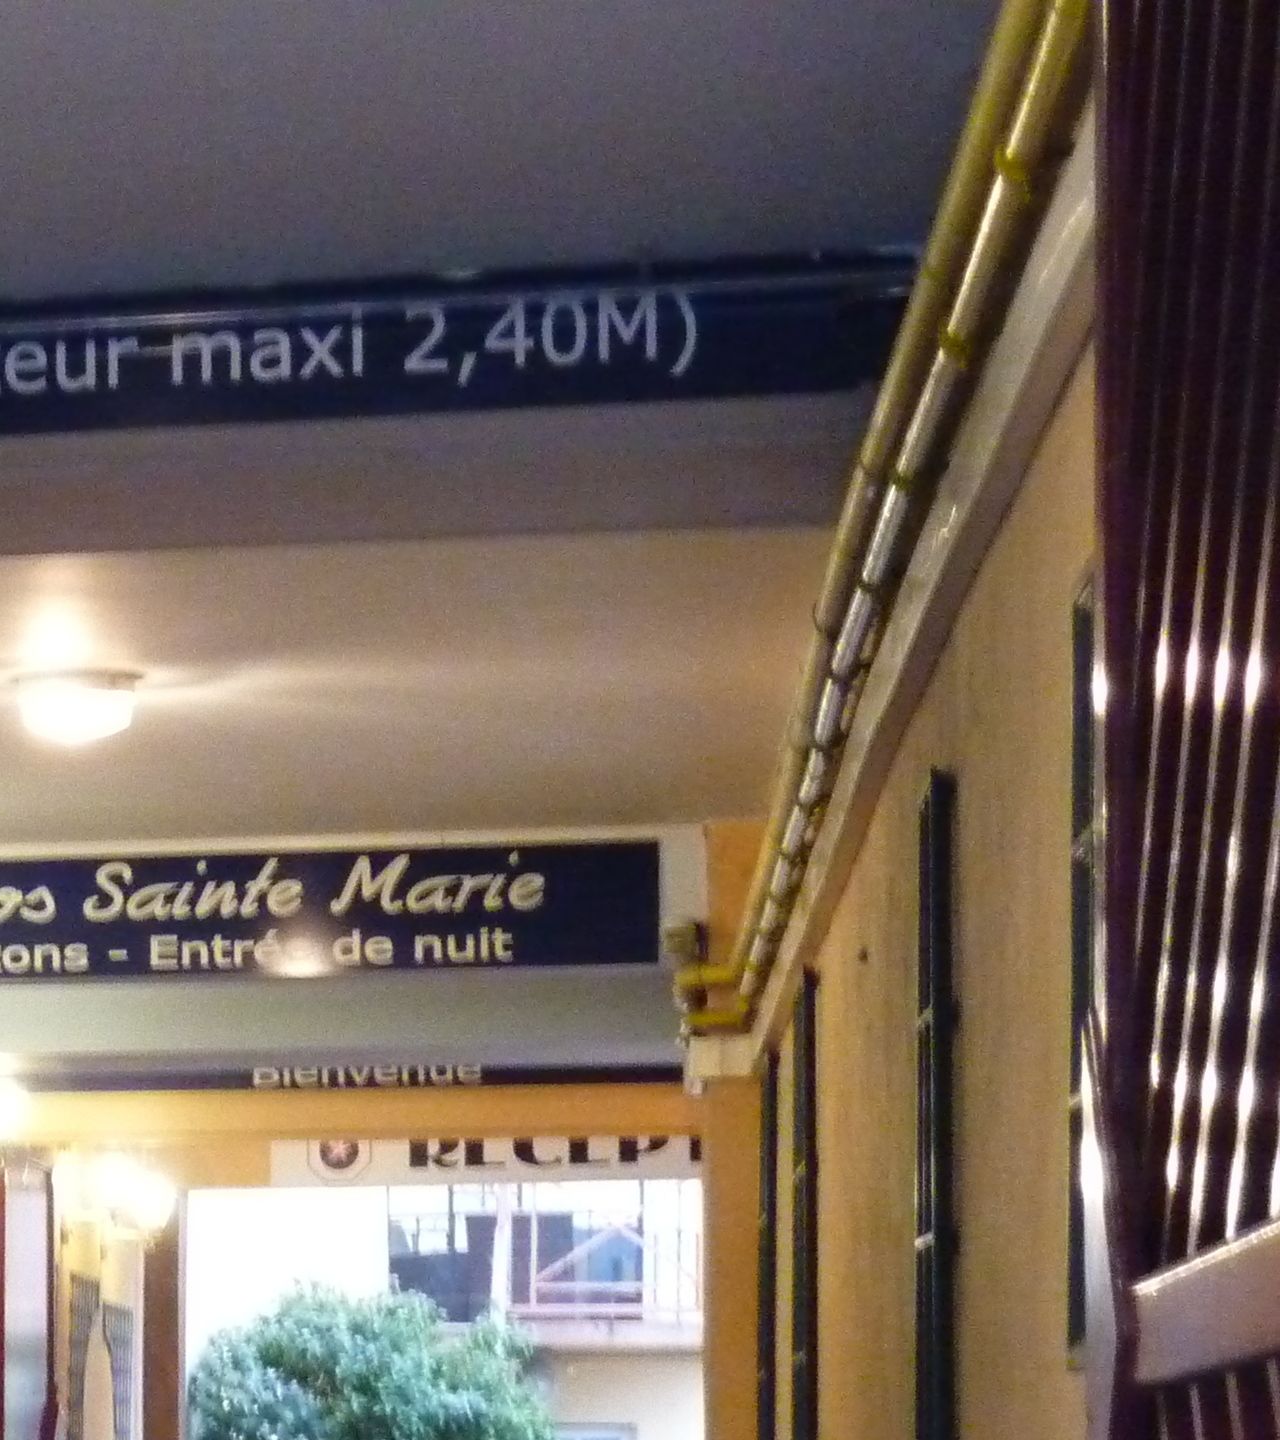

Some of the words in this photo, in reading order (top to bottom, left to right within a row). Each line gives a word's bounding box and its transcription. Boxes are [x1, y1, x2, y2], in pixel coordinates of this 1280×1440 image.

[170, 304, 364, 386] maxi
[402, 286, 698, 387] 2,40M)
[82, 856, 303, 923] Sainte
[329, 849, 546, 915] Marie
[149, 927, 315, 971] Entré
[331, 926, 393, 965] de
[413, 925, 514, 964] nuit
